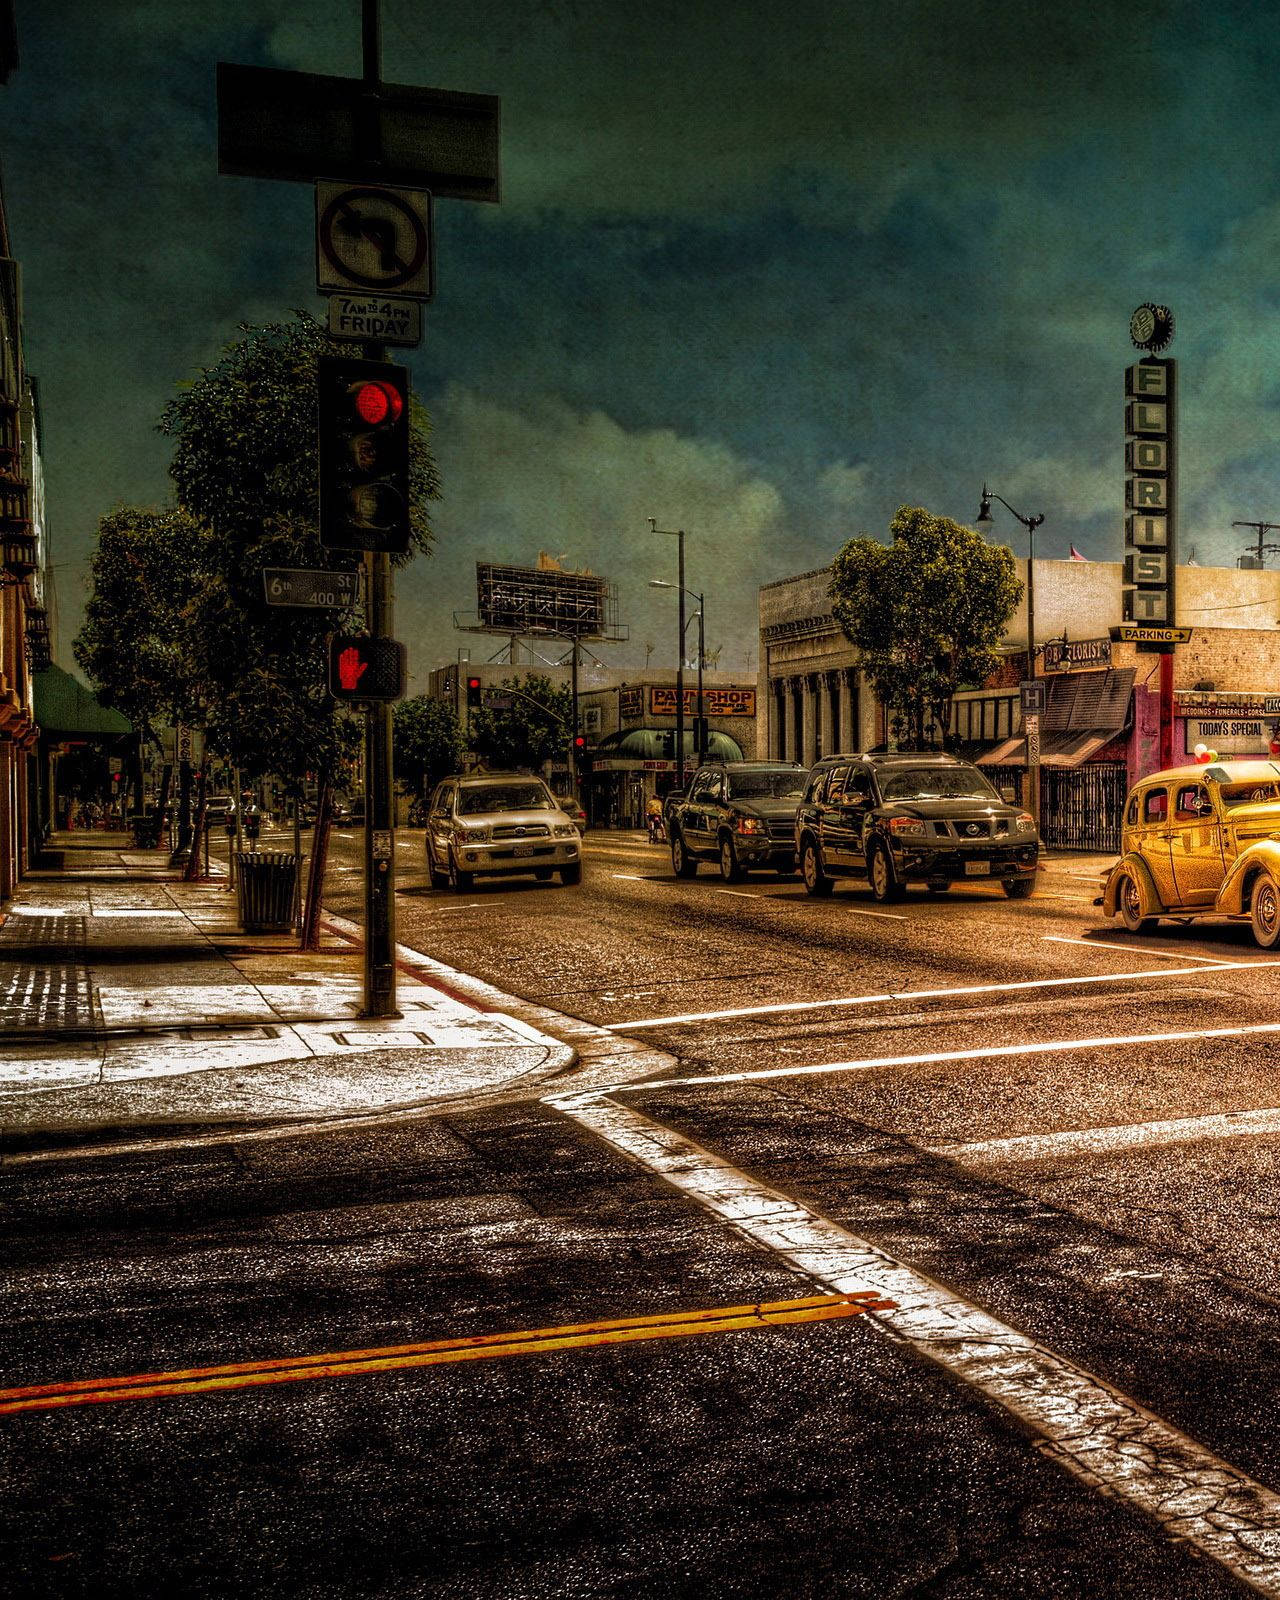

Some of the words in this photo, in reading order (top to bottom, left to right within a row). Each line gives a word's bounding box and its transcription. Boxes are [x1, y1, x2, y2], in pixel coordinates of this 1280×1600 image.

[339, 299, 366, 314] 7AM
[340, 316, 410, 336] FRIDAY
[1137, 368, 1163, 617] FLORIST
[271, 577, 292, 596] 6th
[338, 574, 351, 588] St
[310, 592, 335, 605] 400
[340, 592, 351, 605] W
[1125, 629, 1173, 641] PARKING
[705, 691, 752, 703] SHOP
[1025, 690, 1040, 708] H
[1198, 720, 1229, 736] TODAY'S
[1231, 721, 1263, 736] SPECIAL
